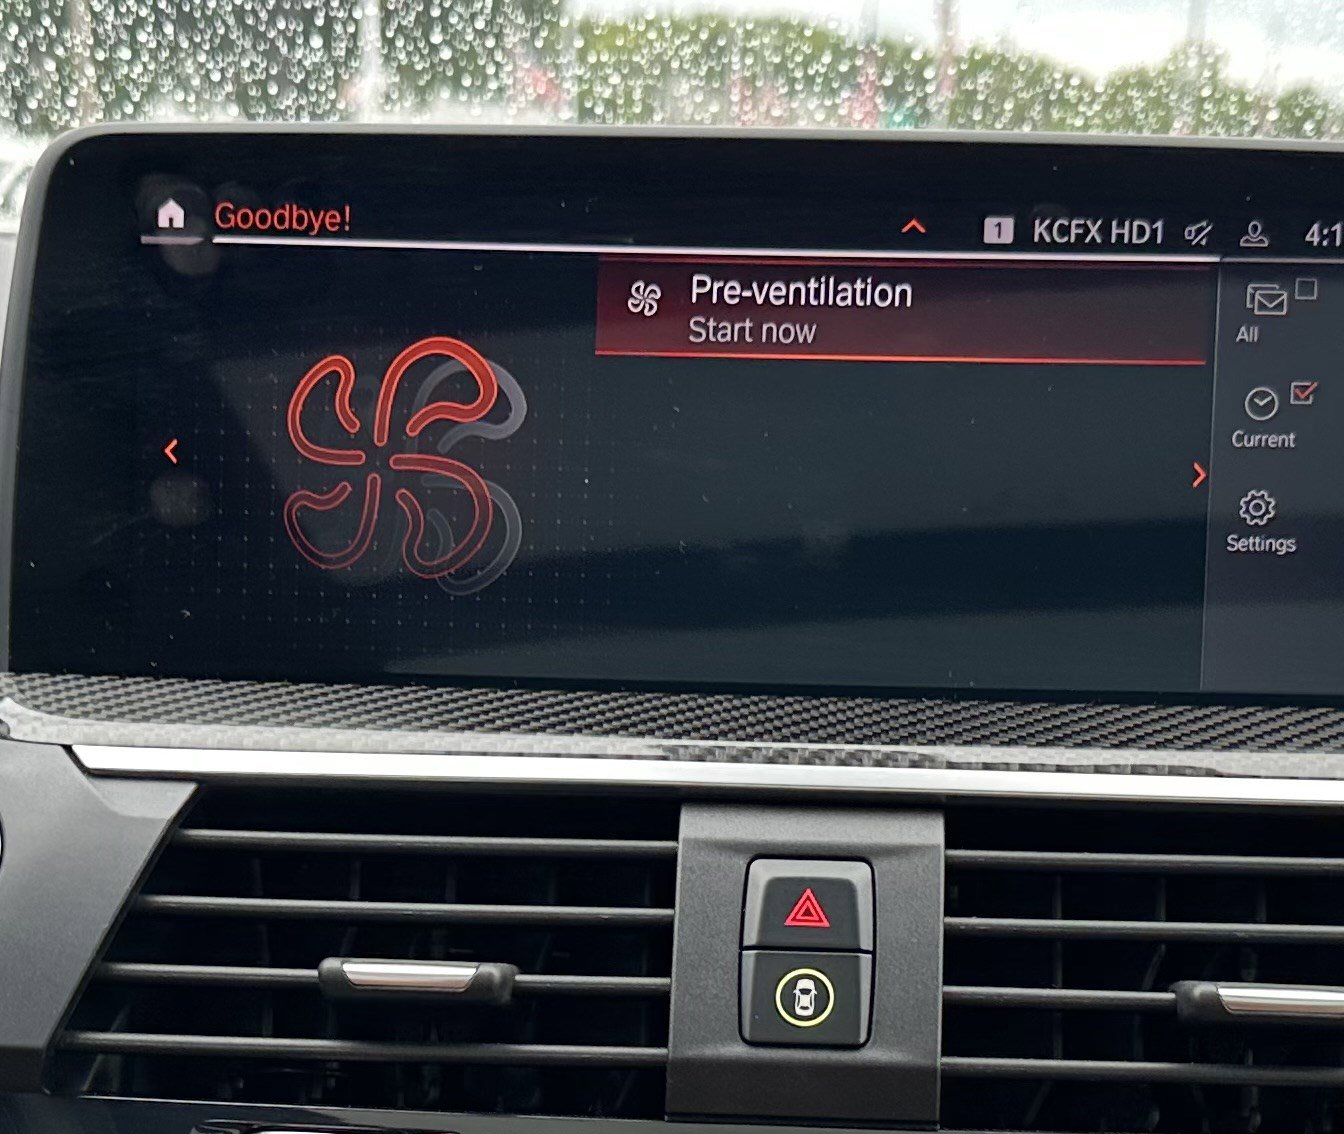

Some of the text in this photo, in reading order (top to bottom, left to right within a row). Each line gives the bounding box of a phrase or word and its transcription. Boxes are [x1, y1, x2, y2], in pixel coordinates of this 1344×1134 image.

[214, 201, 352, 235] Goodbye!
[992, 219, 1165, 245] 1 KCFX HD1
[690, 274, 912, 308] Pre-ventilation
[688, 315, 818, 345] Start now
[1236, 325, 1259, 342] All
[1232, 431, 1296, 450] Current
[1227, 535, 1297, 556] Settings
